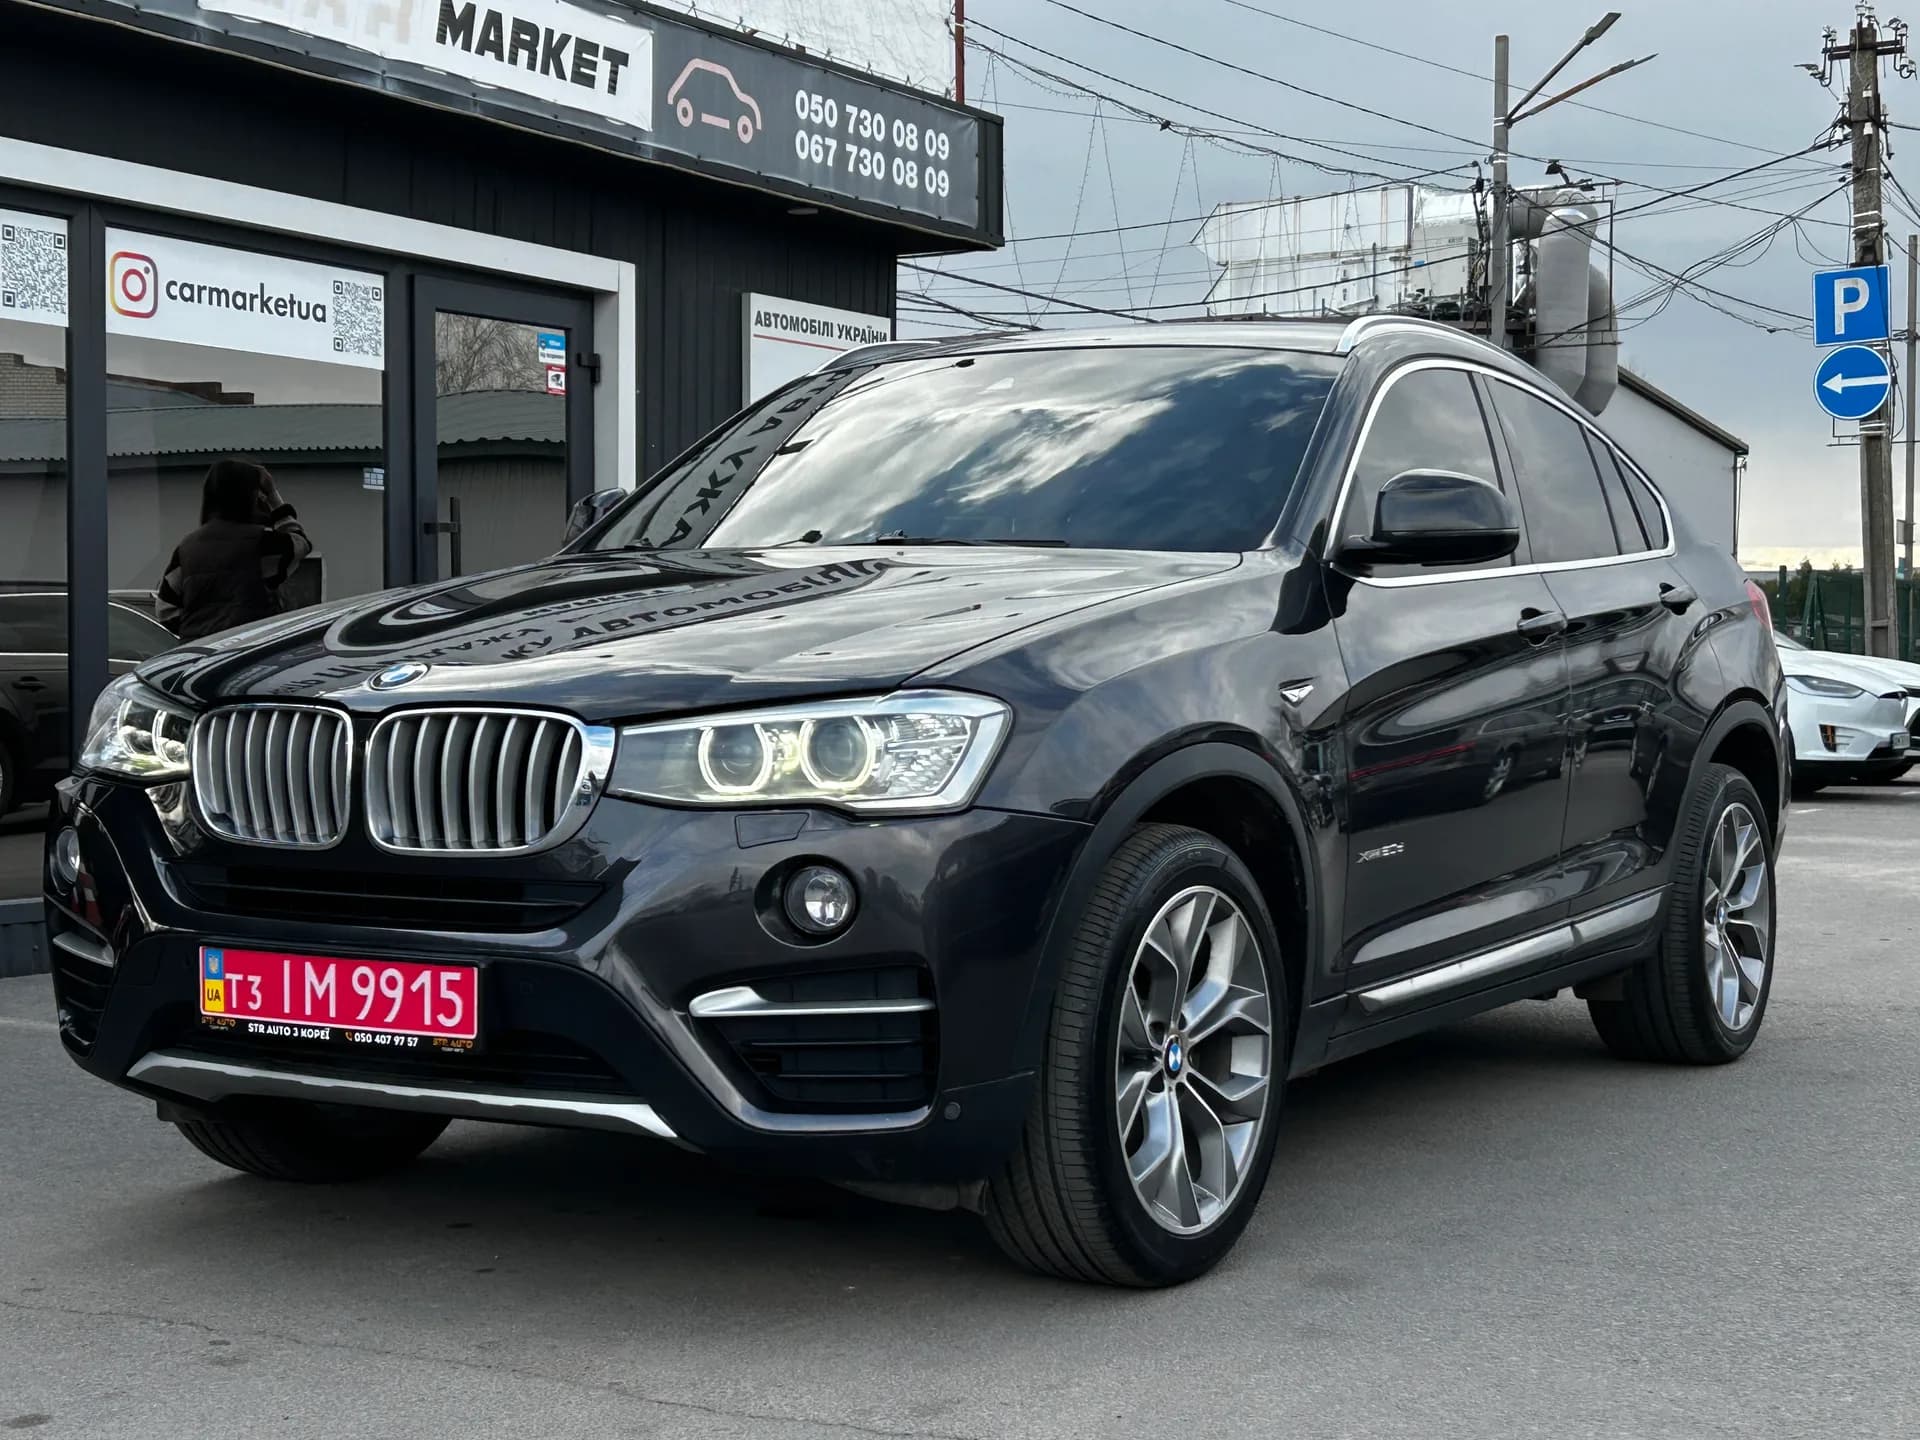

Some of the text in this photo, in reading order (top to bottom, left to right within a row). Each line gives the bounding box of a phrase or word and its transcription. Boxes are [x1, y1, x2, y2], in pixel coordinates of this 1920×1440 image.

[436, 0, 629, 95] MARKET
[795, 89, 950, 160] 050 730 08 09
[795, 130, 950, 197] 067 730 08 09
[165, 280, 327, 323] carmarketua
[1834, 277, 1870, 335] P
[754, 310, 887, 344] АВТОМОБІЛІ УКРАЇНИ
[207, 988, 221, 1002] UA
[351, 965, 464, 1027] 9915
[248, 1022, 265, 1034] STR
[266, 1025, 291, 1036] AUTO
[354, 1032, 418, 1047] 050 407 97 57
